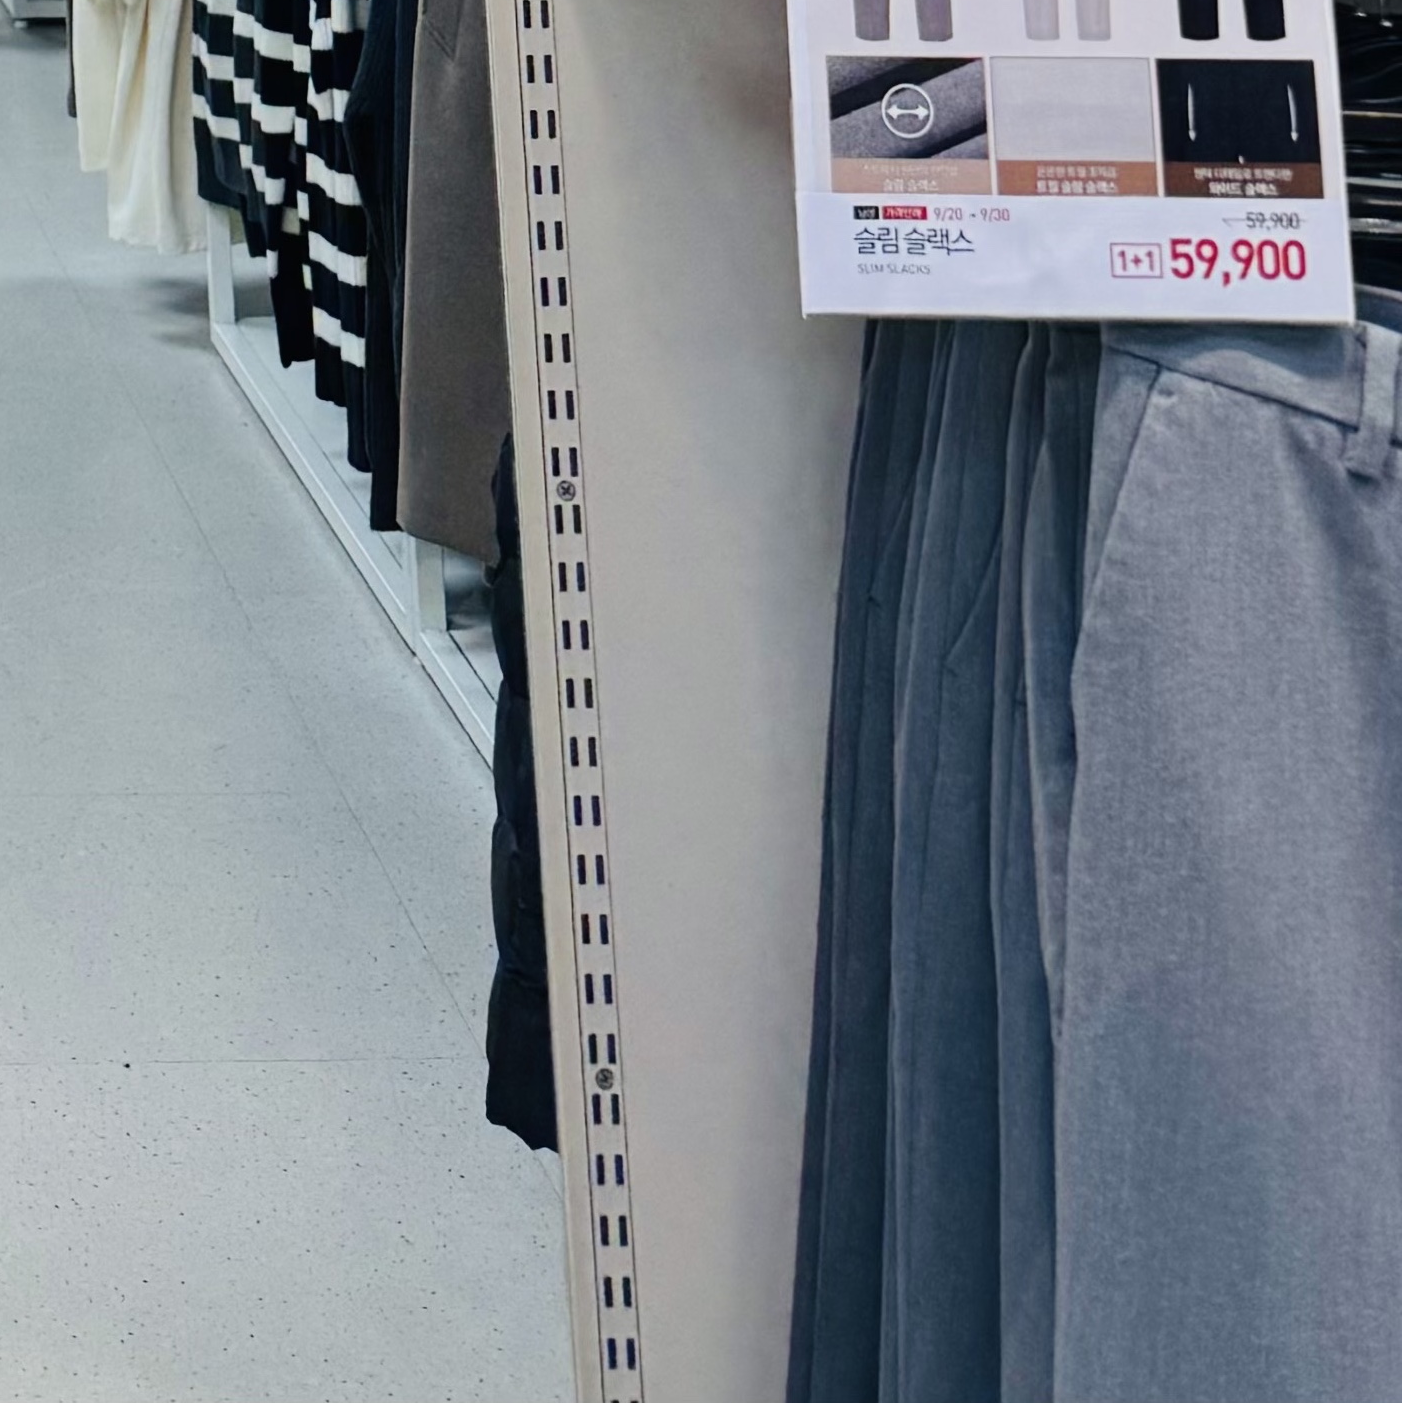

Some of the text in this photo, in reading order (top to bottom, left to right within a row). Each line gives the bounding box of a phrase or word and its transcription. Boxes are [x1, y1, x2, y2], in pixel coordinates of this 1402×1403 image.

[934, 208, 963, 221] 9/20
[980, 208, 1010, 222] 9/30
[1245, 212, 1300, 231] 59,900
[854, 227, 975, 256] 슬림 슬랙스
[857, 263, 931, 275] SLIM SLACKS
[1117, 238, 1307, 287] 1+1 59,900
